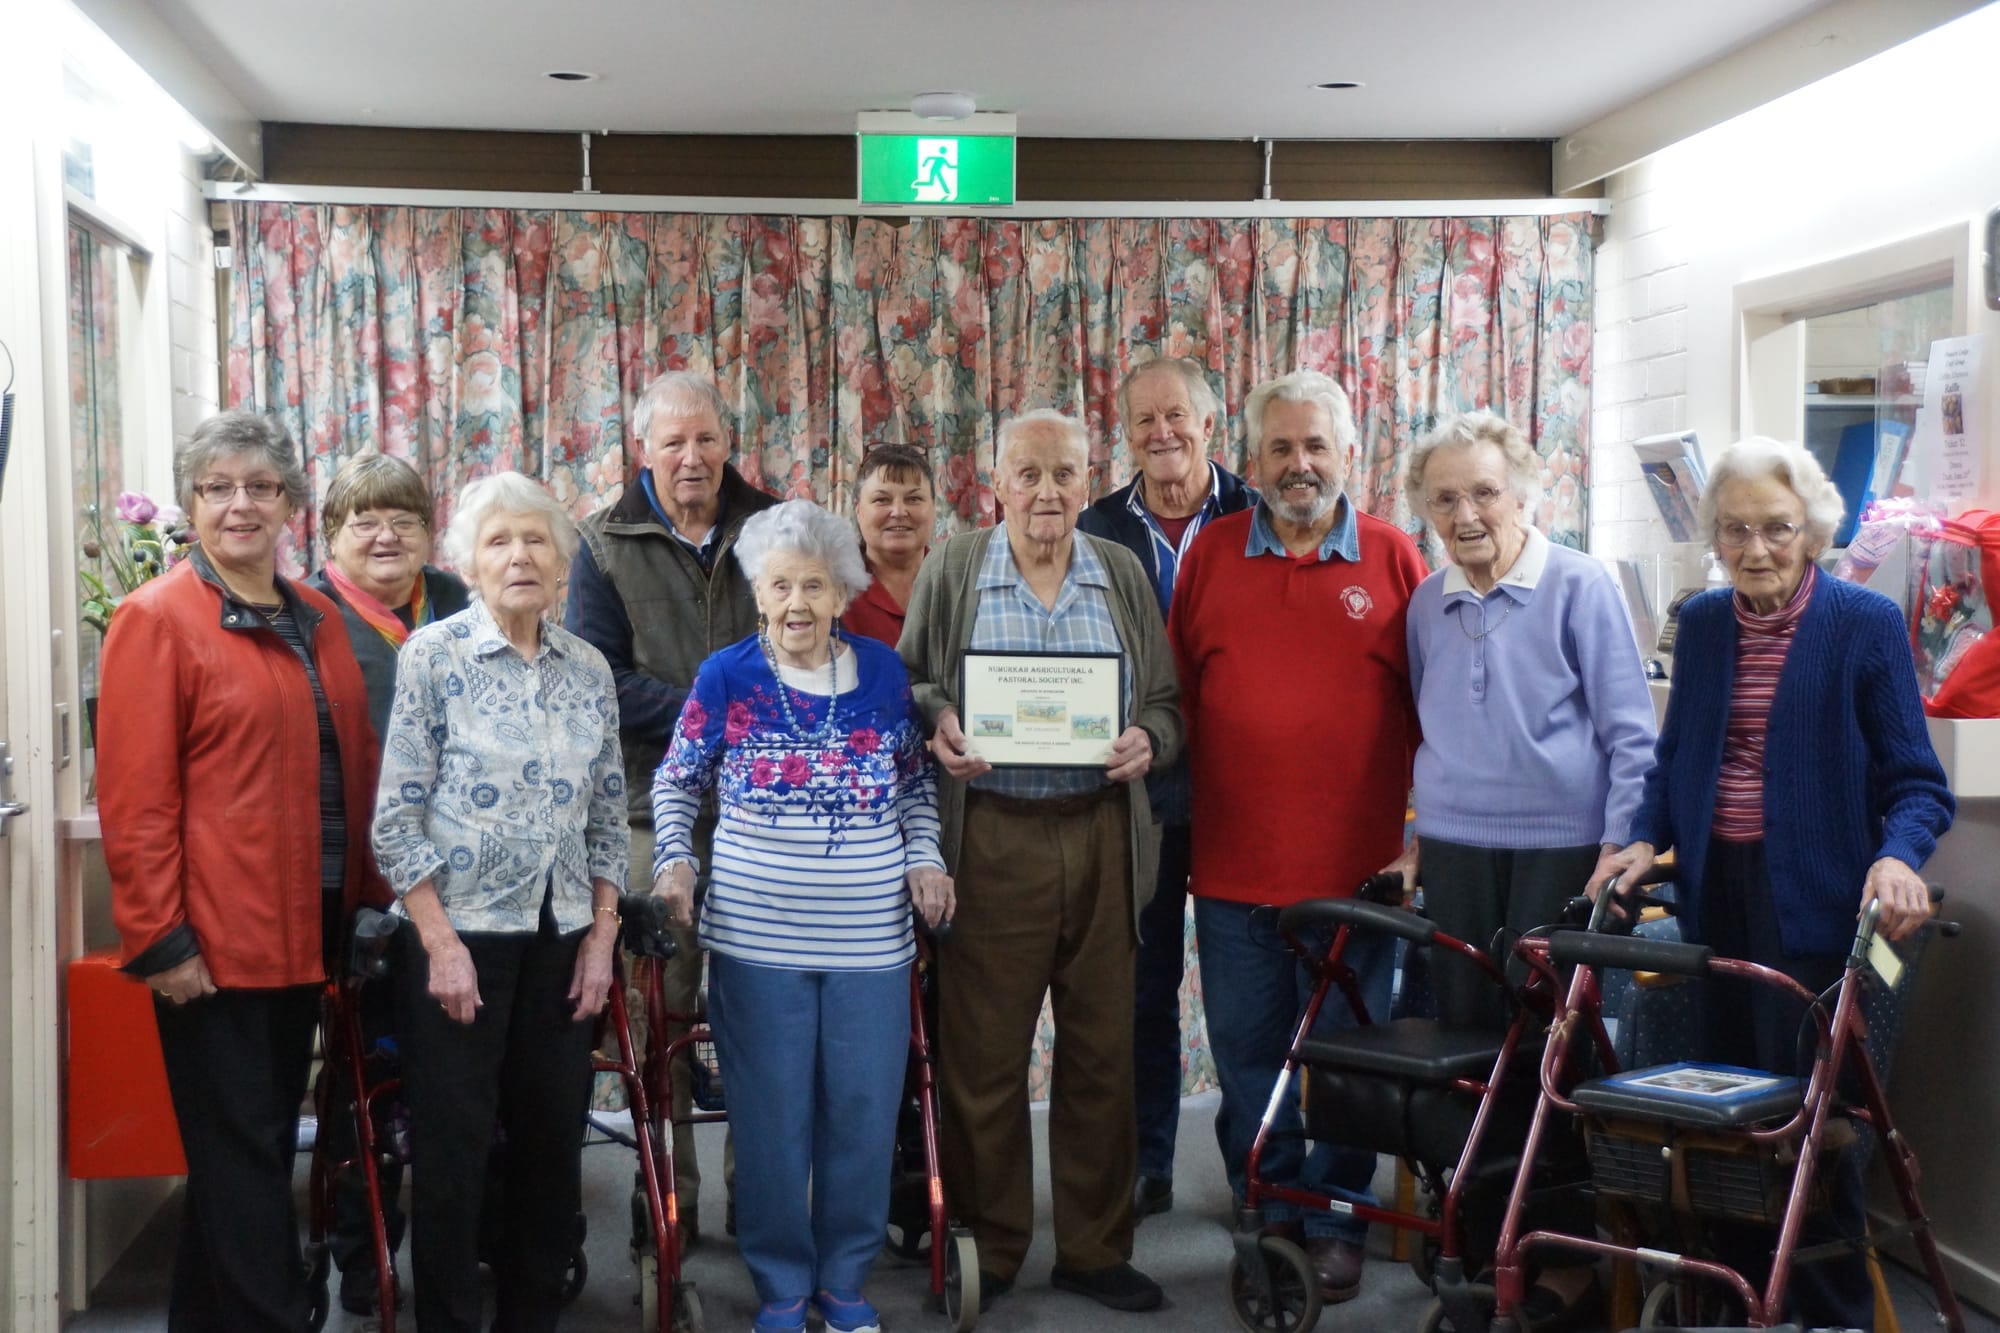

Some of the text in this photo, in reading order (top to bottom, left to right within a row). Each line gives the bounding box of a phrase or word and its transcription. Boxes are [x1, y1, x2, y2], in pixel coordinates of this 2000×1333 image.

[1030, 666, 1086, 674] AGRICULTURAL
[998, 676, 1037, 684] PASTORAL
[1038, 676, 1070, 684] SOCIETY
